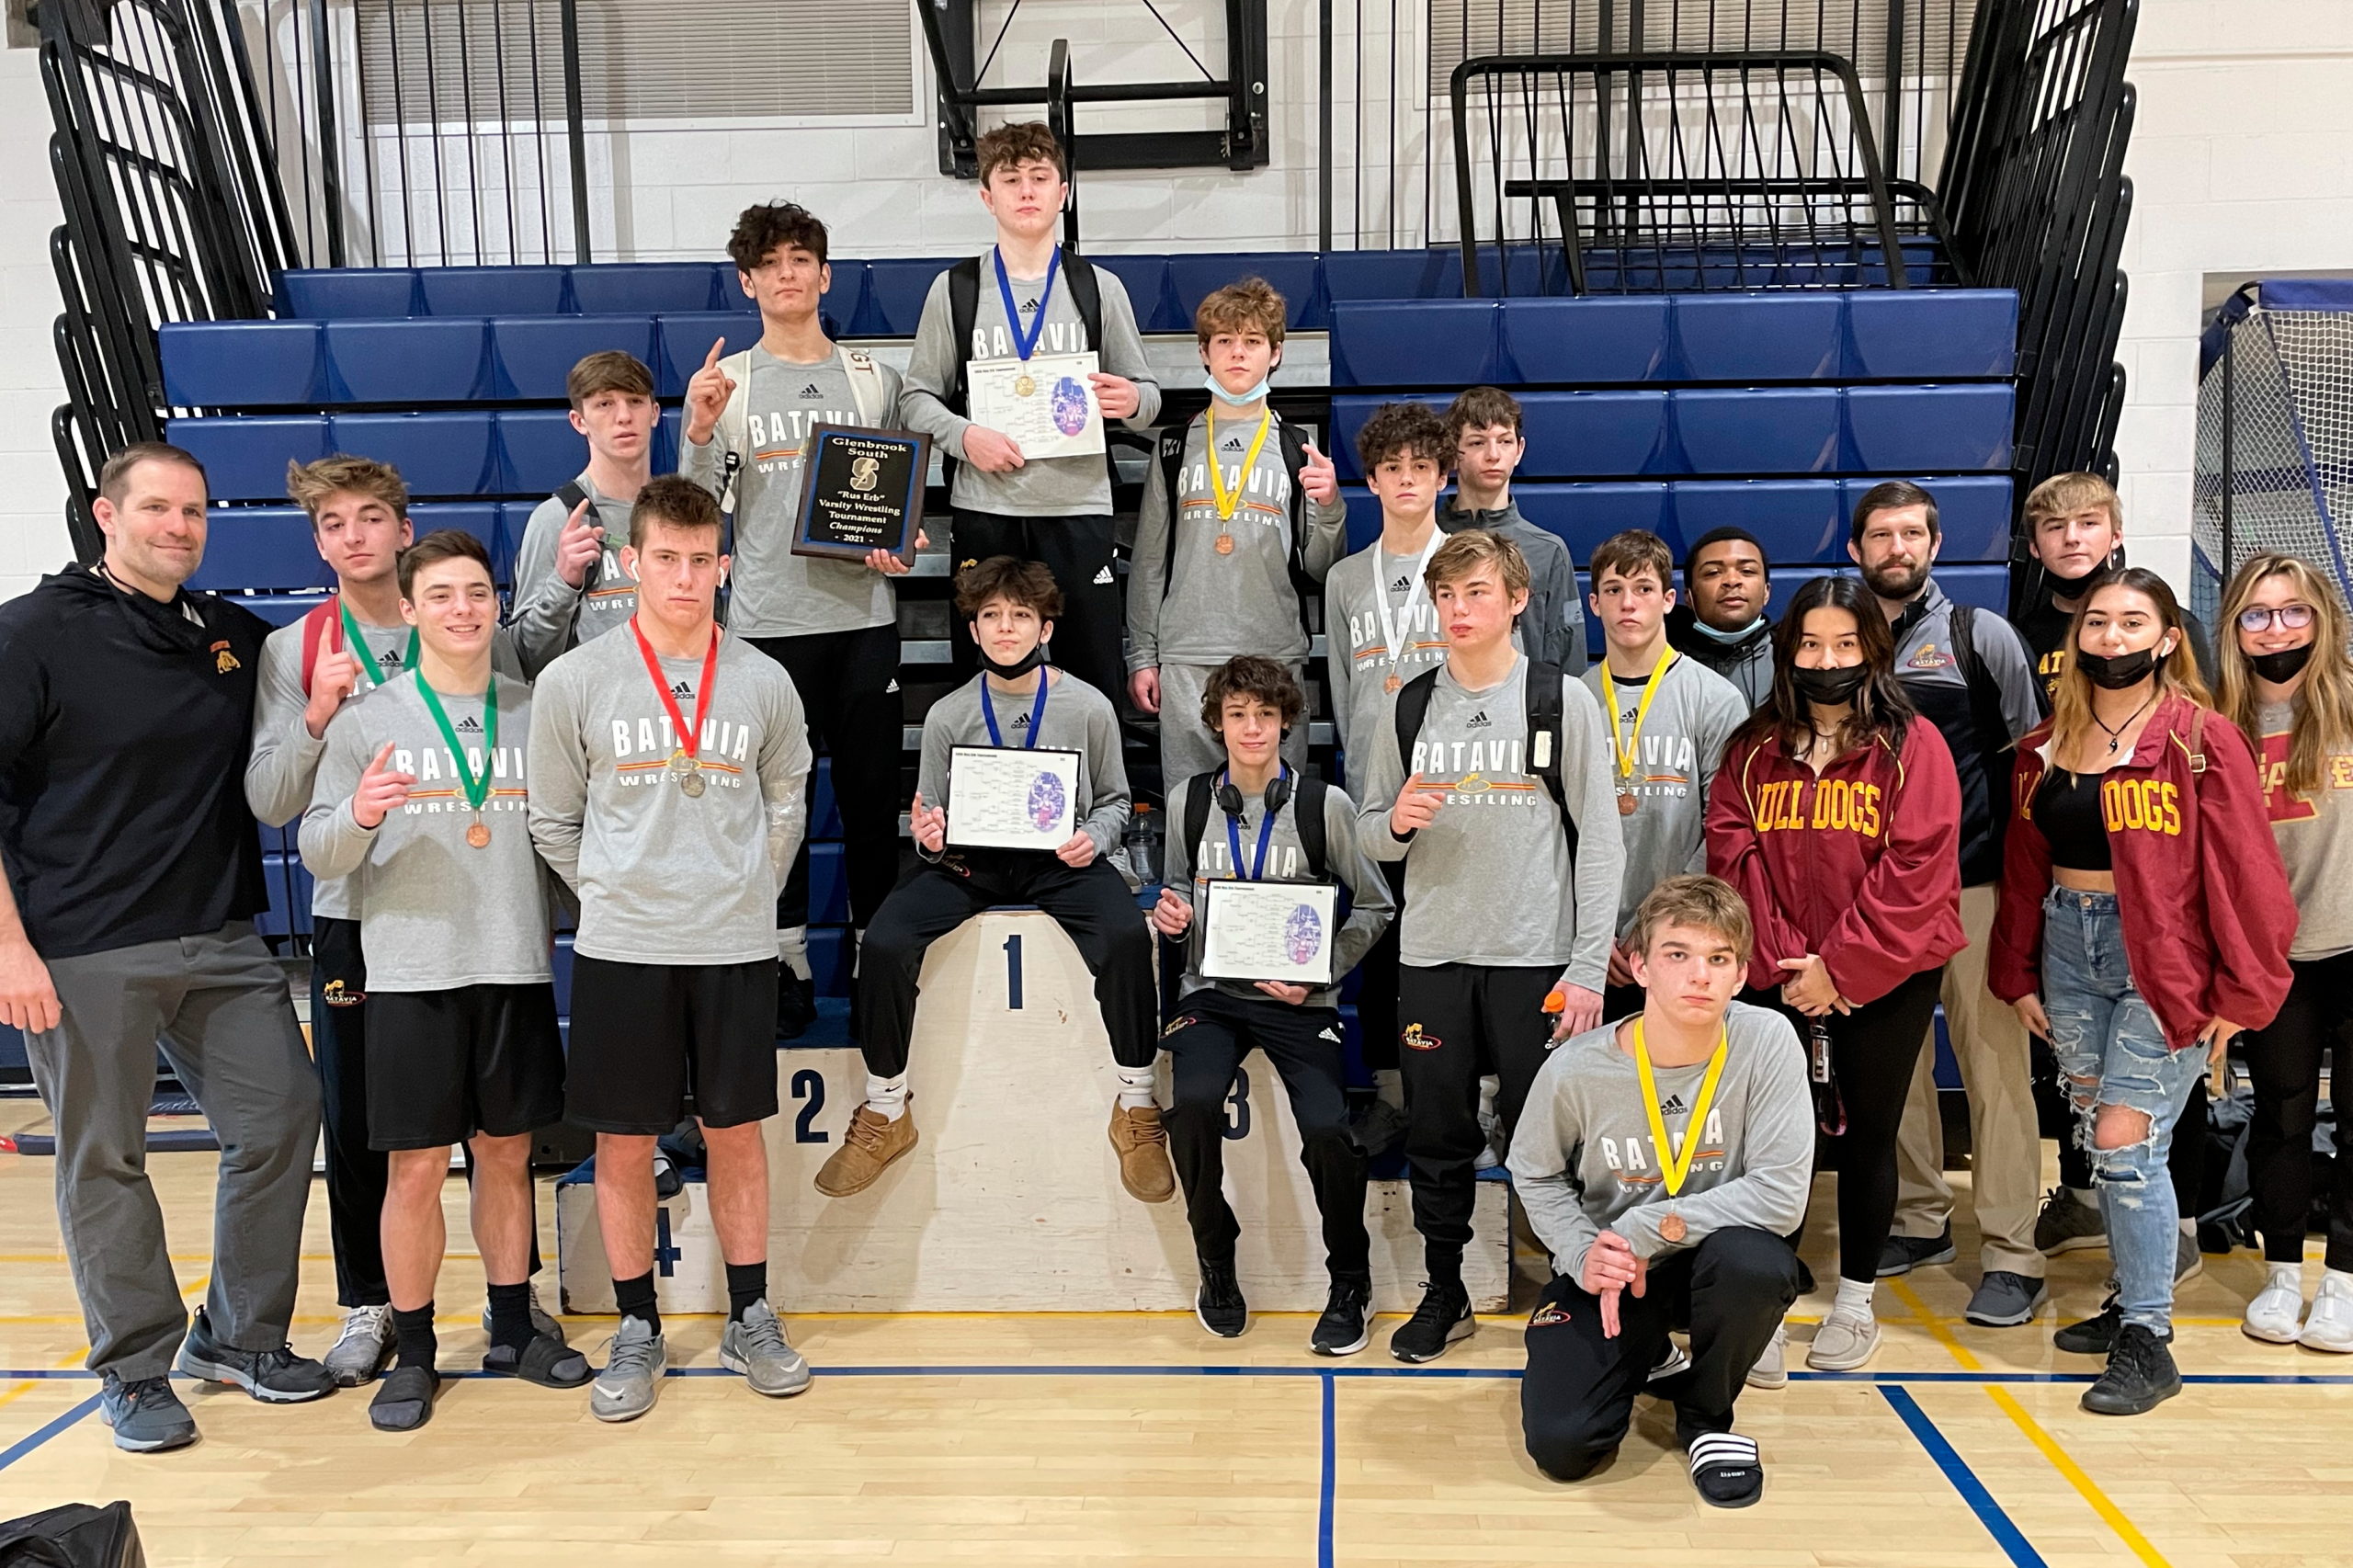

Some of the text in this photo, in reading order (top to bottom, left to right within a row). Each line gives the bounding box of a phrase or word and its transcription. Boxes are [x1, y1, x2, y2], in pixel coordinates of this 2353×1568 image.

[748, 410, 855, 449] BATAVI
[832, 437, 907, 452] Glenbrook
[847, 448, 889, 459] South
[1178, 464, 1289, 505] BAAVIA
[819, 499, 901, 517] Varsity Wrestling
[828, 510, 887, 524] Tournament
[829, 521, 882, 534] Champions
[843, 534, 864, 542] 2021
[394, 747, 524, 781] BATAVI
[1412, 739, 1538, 778] BATAVI
[619, 771, 742, 789] WRESING
[1447, 794, 1537, 806] ESTLING
[1615, 786, 1688, 799] STLING
[404, 801, 528, 814] WRESTLIN
[1756, 778, 1881, 838] ULL DOGS
[2103, 779, 2181, 835] DOGS
[1002, 934, 1023, 1010] 1
[791, 1069, 829, 1143] 2
[1222, 1066, 1251, 1140] 3
